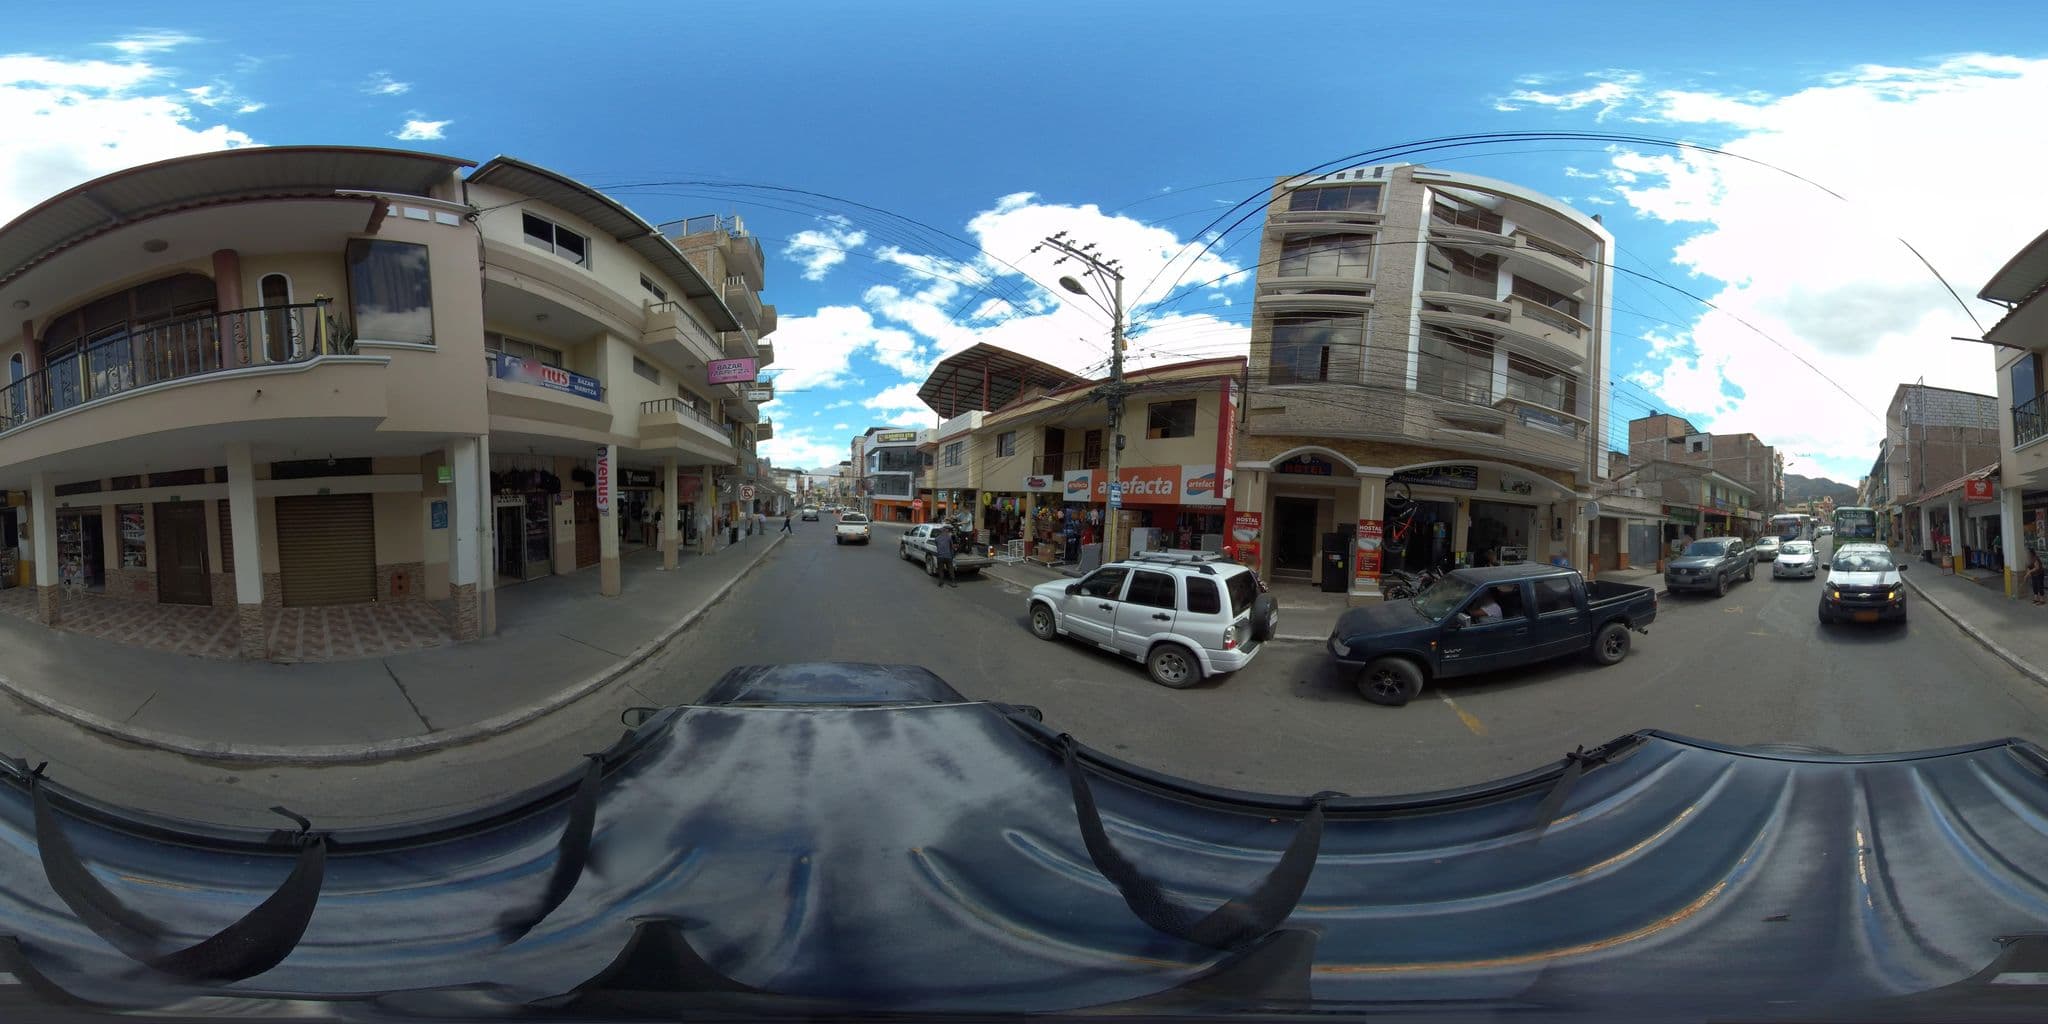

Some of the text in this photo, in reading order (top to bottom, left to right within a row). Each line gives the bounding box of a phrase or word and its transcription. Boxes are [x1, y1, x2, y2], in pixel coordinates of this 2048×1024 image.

[598, 457, 608, 504] venus
[1097, 475, 1174, 495] aefacta
[1188, 479, 1216, 489] artefact
